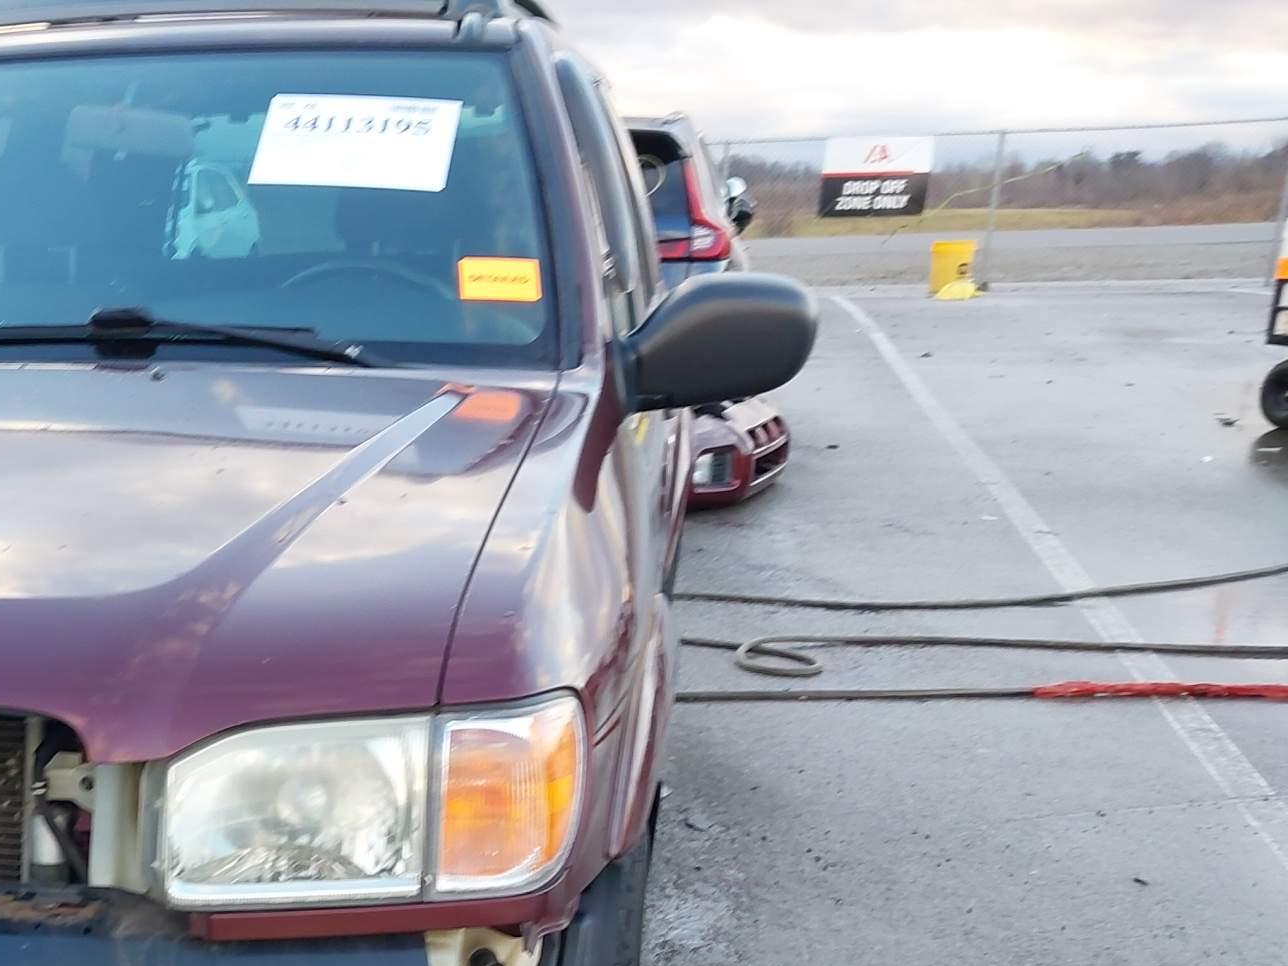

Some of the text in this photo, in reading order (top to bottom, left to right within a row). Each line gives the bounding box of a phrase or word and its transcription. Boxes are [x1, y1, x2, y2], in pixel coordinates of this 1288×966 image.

[284, 114, 433, 136] 44113195
[842, 178, 909, 195] DROP OFF
[834, 194, 912, 211] ZONE ONLY
